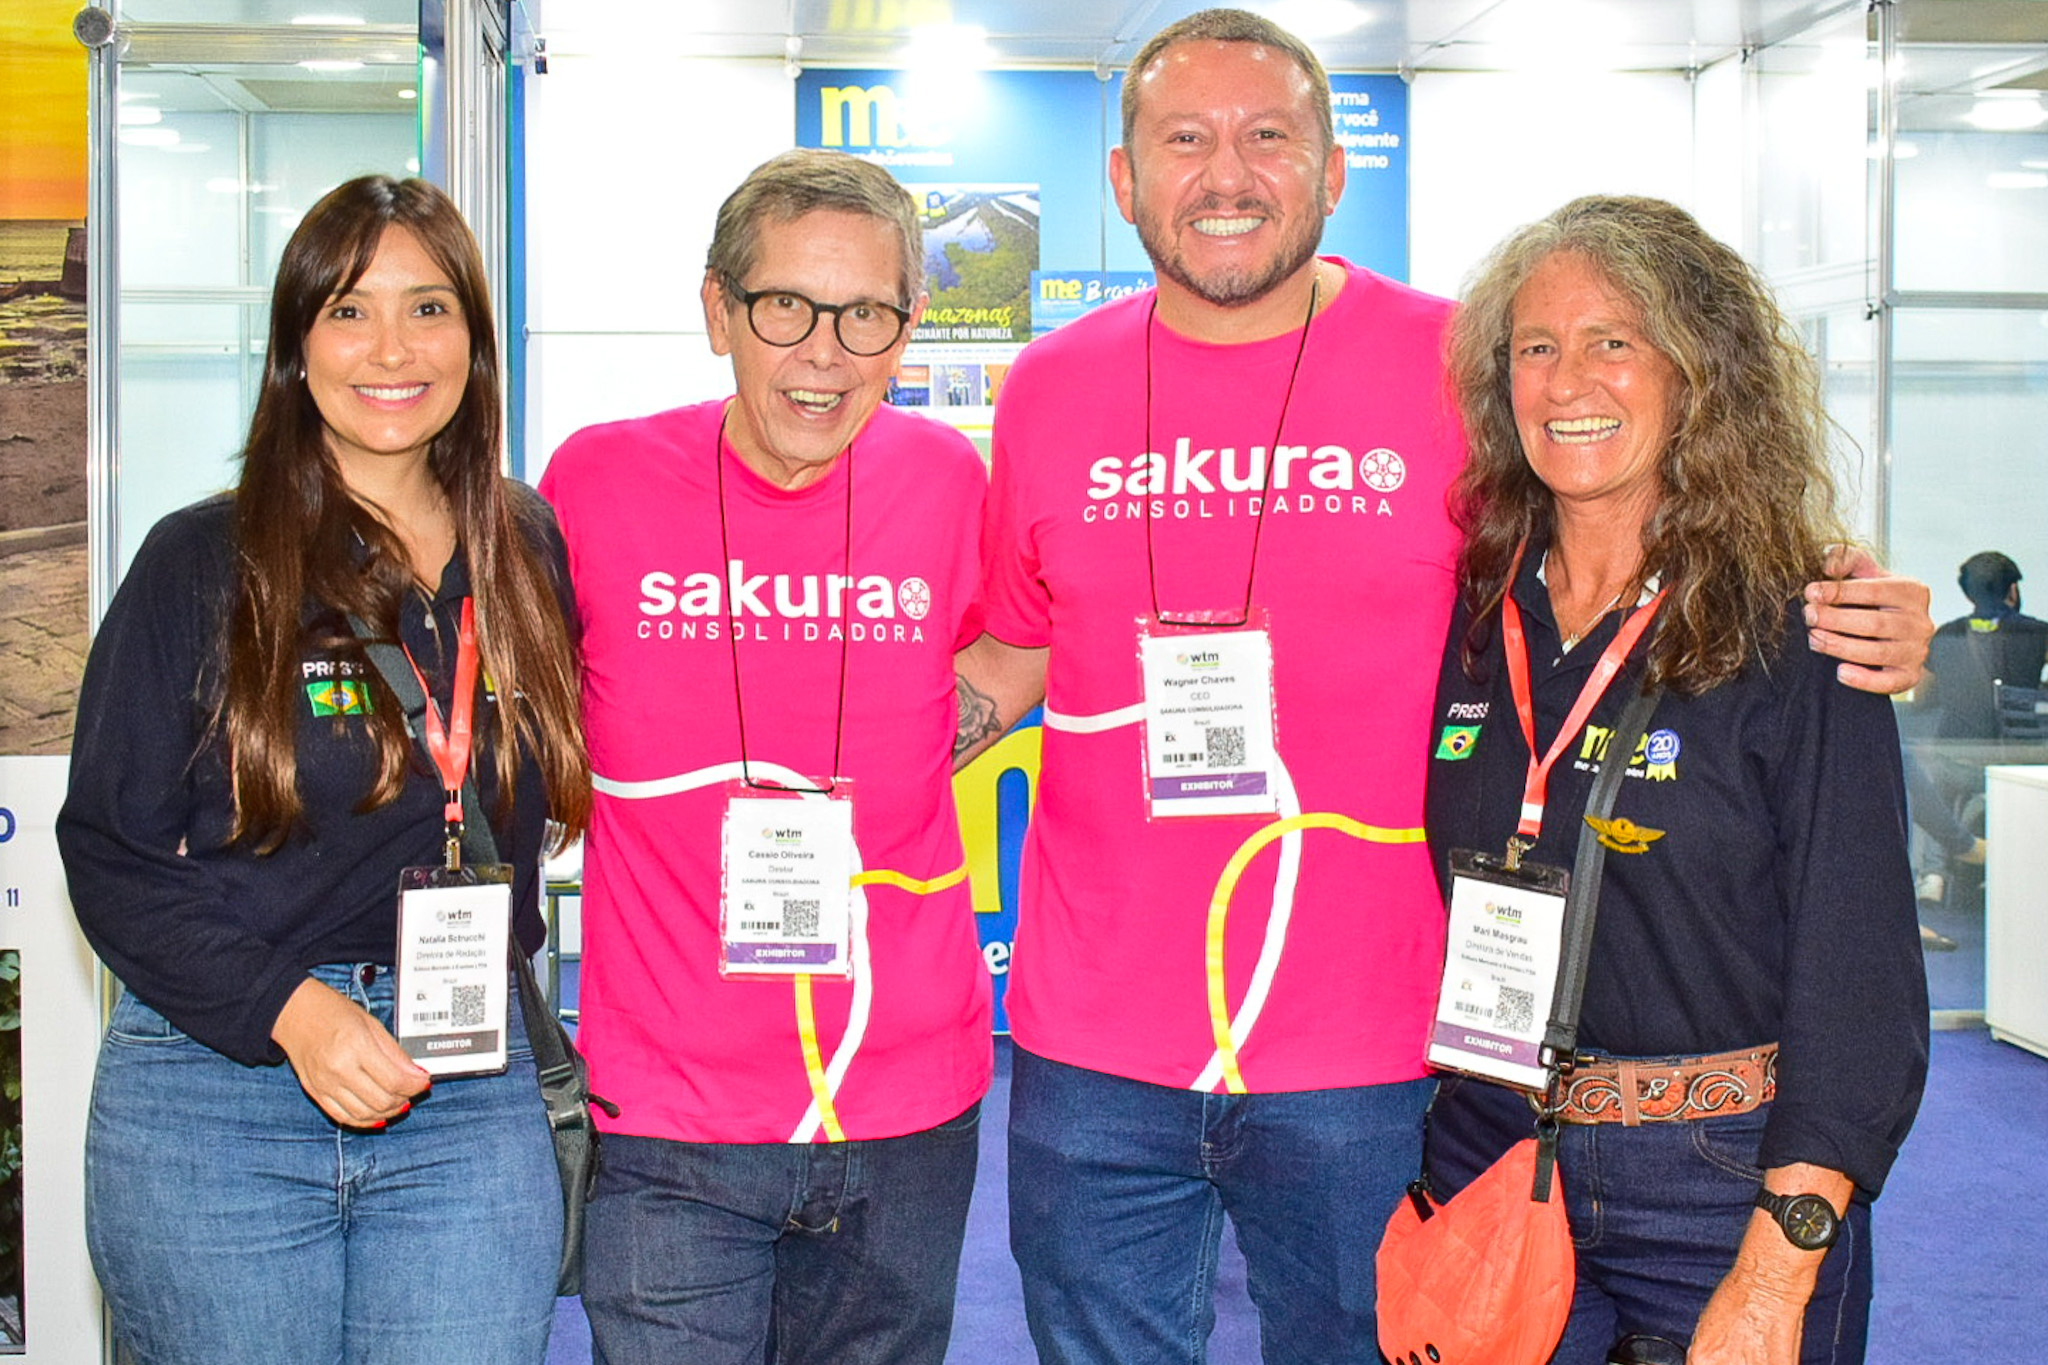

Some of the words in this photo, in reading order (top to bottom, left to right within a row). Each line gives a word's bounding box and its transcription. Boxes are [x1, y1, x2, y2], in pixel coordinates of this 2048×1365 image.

[1343, 109, 1379, 127] você
[1040, 279, 1083, 299] me
[921, 305, 1012, 328] mazonas
[1087, 437, 1354, 500] sakura
[1083, 494, 1392, 523] CONSOLIDADORA
[638, 559, 896, 619] sakura
[637, 620, 924, 642] CONSOLIDADORA
[1191, 651, 1219, 662] wtm
[1164, 678, 1198, 688] Wagner
[1201, 675, 1235, 685] Chaves
[1190, 692, 1210, 701] CEO
[1652, 736, 1673, 752] 20
[1180, 780, 1234, 792] EXHIBITOR
[775, 828, 802, 838] wtm
[748, 850, 779, 859] Cassio
[781, 850, 815, 859] Oliveira
[7, 887, 19, 907] 11
[448, 909, 472, 920] wtm
[1497, 905, 1522, 919] wtm
[1492, 929, 1528, 945] Masgrau
[755, 949, 806, 958] EXHIBITOR
[427, 1038, 472, 1051] EXHIBITOR
[1464, 1034, 1513, 1055] EXHIBITOR
